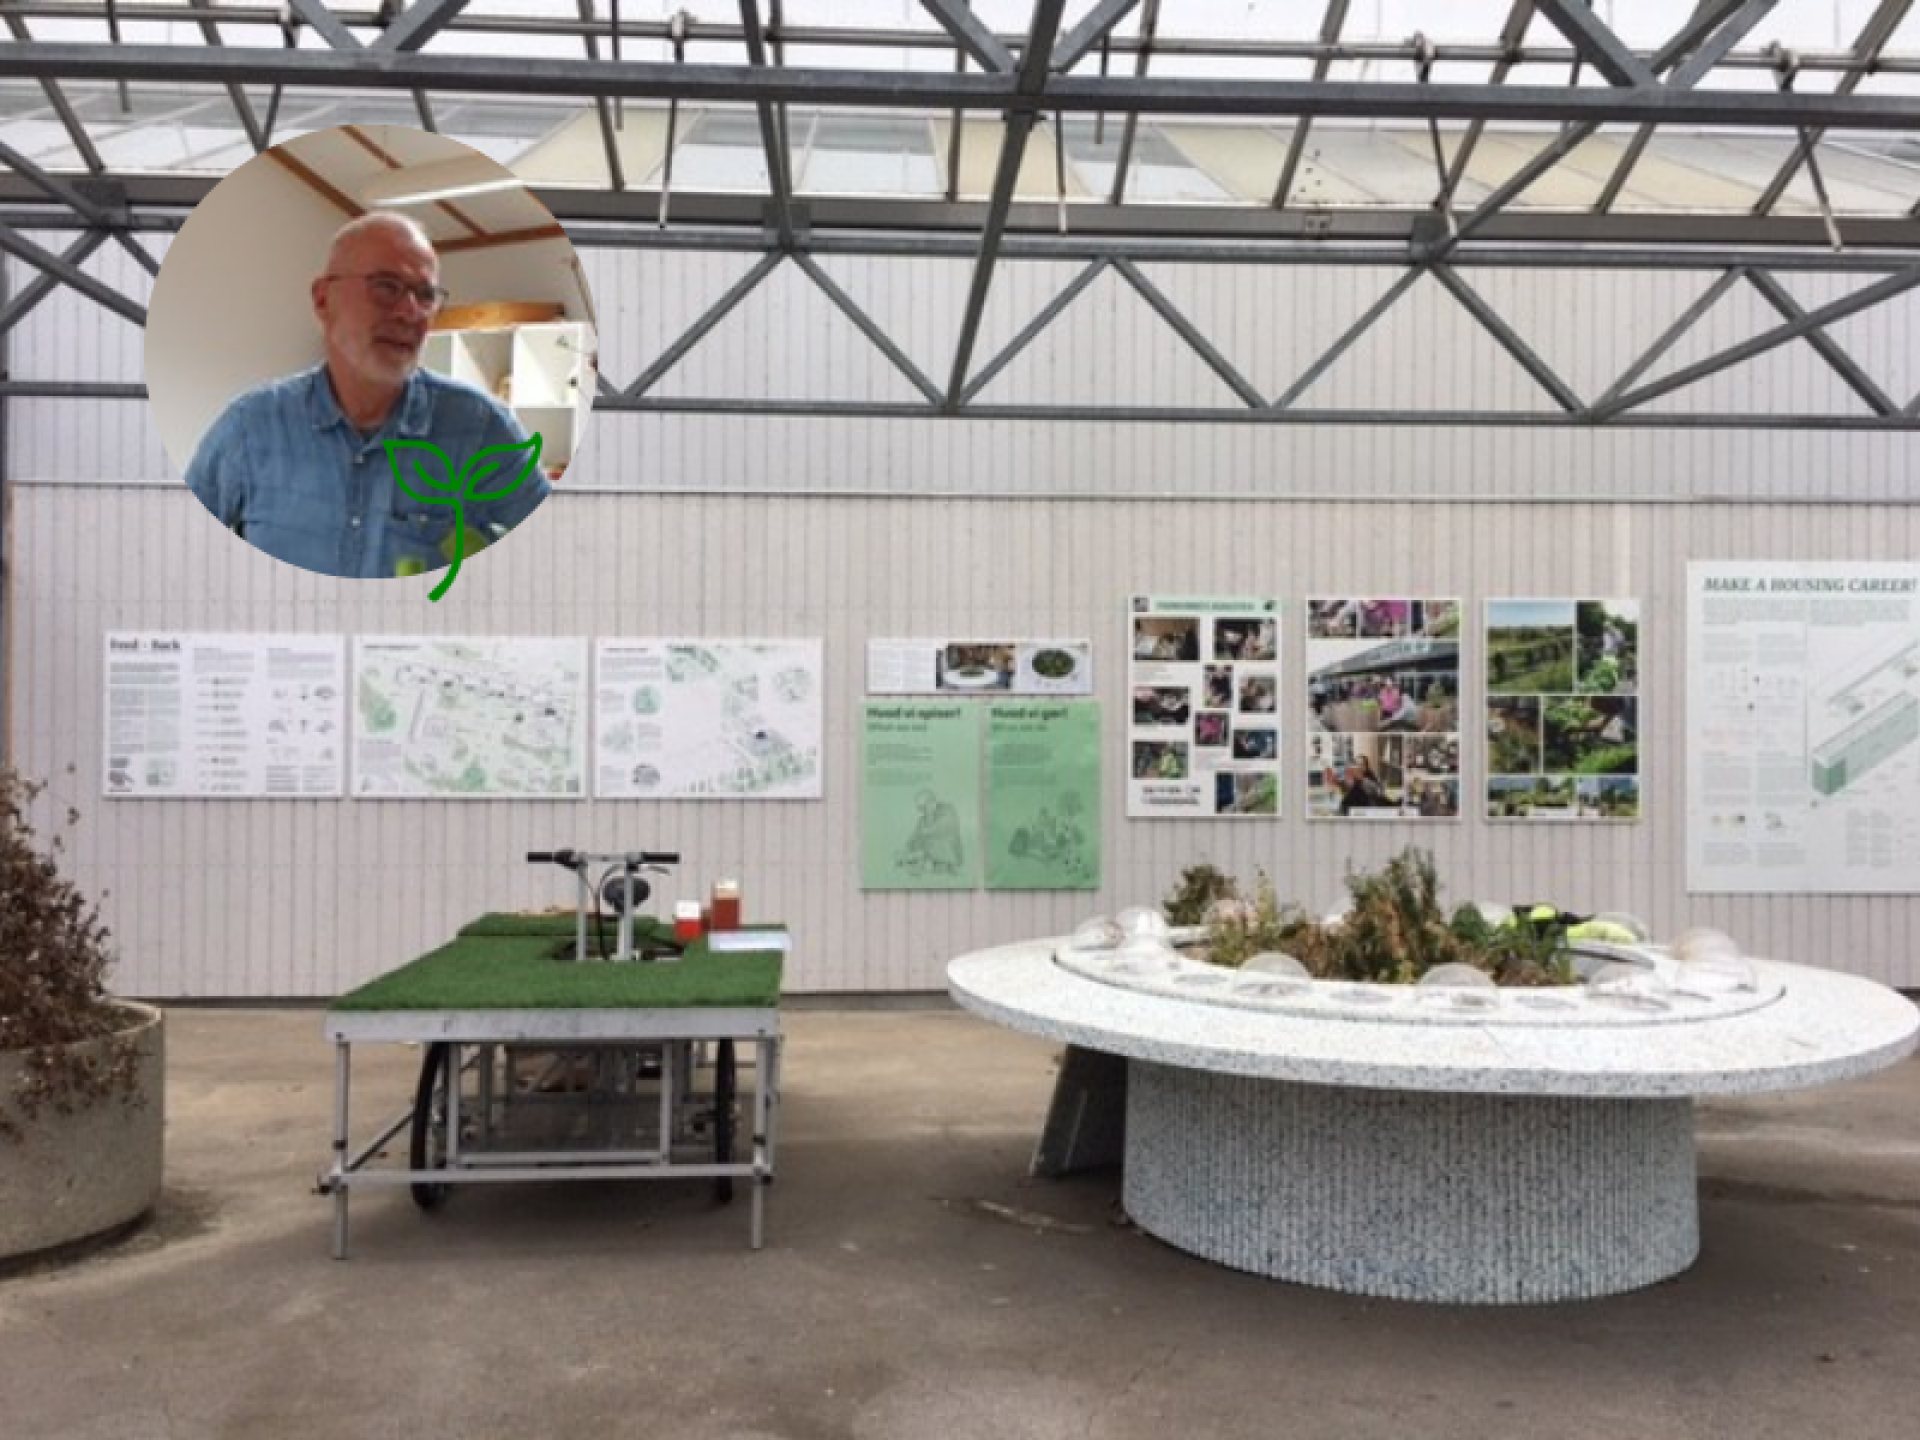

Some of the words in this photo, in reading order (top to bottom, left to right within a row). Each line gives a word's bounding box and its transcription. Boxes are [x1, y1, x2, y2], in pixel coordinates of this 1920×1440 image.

[1703, 577, 1751, 592] MAKE
[1756, 577, 1767, 592] A
[1770, 577, 1844, 592] HOUSING
[1848, 577, 1917, 592] CAREER!
